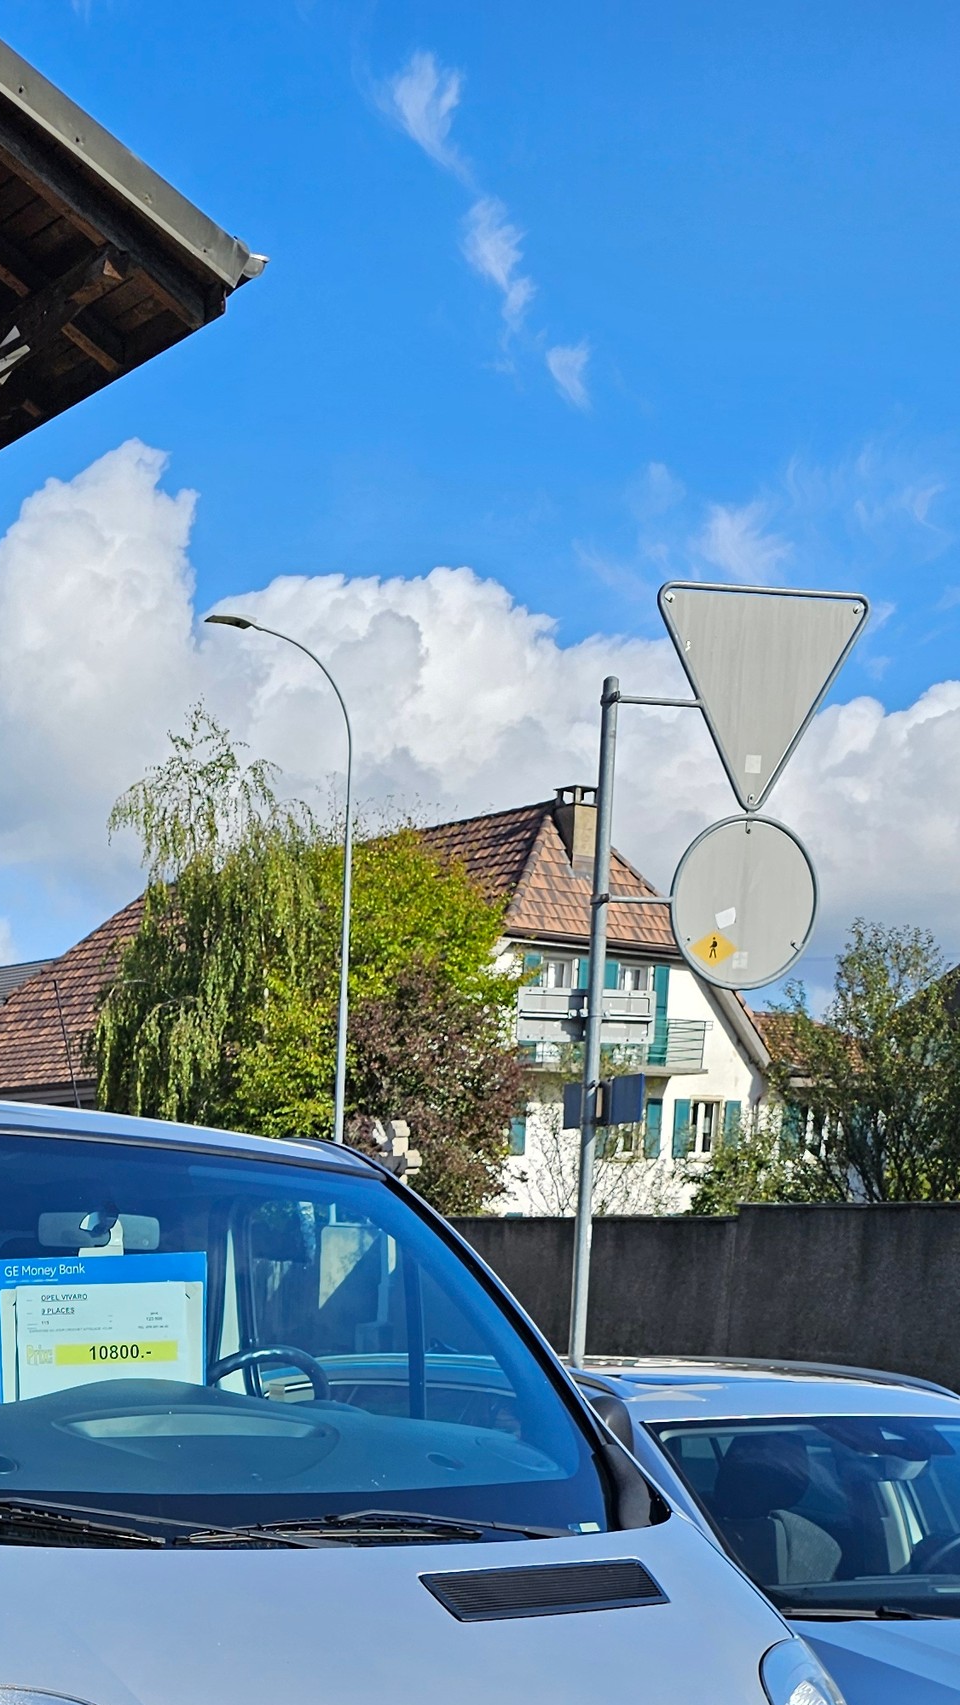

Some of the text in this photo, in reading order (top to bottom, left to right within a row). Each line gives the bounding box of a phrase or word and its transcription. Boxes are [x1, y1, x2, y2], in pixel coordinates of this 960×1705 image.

[4, 1262, 86, 1278] GE Money Bank
[41, 1293, 88, 1302] OPEL VIVARO
[47, 1307, 75, 1315] PLACES
[89, 1344, 152, 1360] 10800.-
